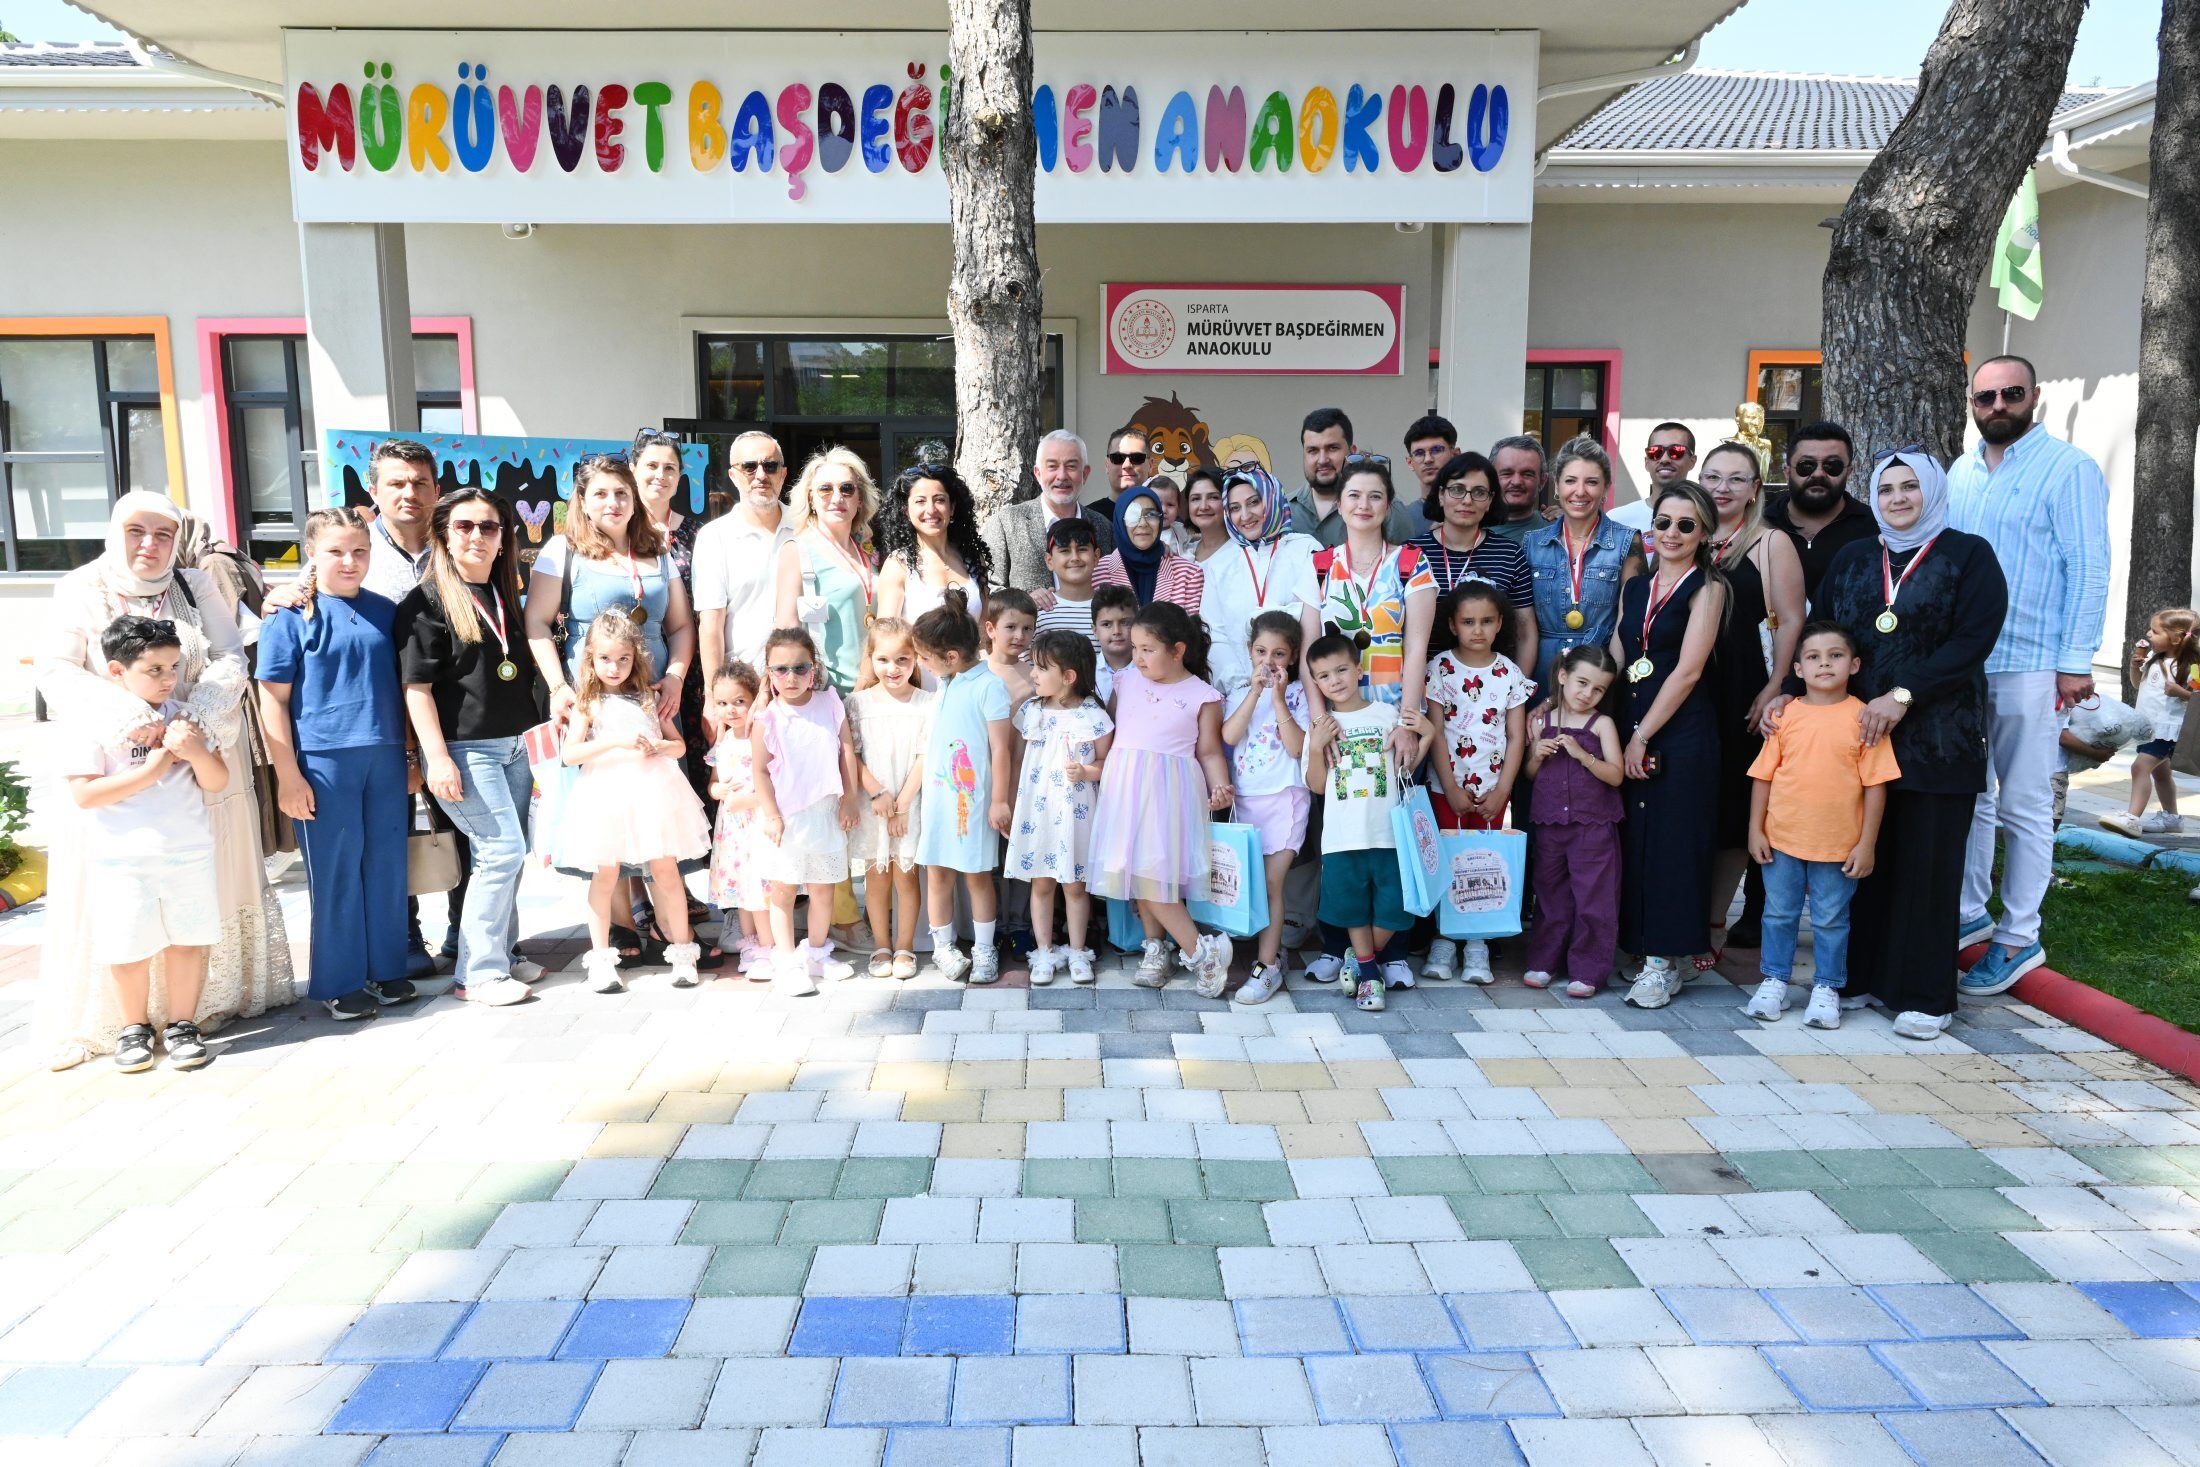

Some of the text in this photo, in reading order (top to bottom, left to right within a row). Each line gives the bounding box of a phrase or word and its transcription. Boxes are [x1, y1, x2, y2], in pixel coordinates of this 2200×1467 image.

[298, 61, 672, 173] MÜRÜVVET
[1154, 83, 1509, 173] ANAOKULU
[1187, 304, 1229, 314] ISPARTA
[1187, 319, 1272, 337] MÜRÜVVET
[1276, 319, 1384, 340] BAŞDEĞİRMEN
[1187, 342, 1271, 356] ANAOKULU
